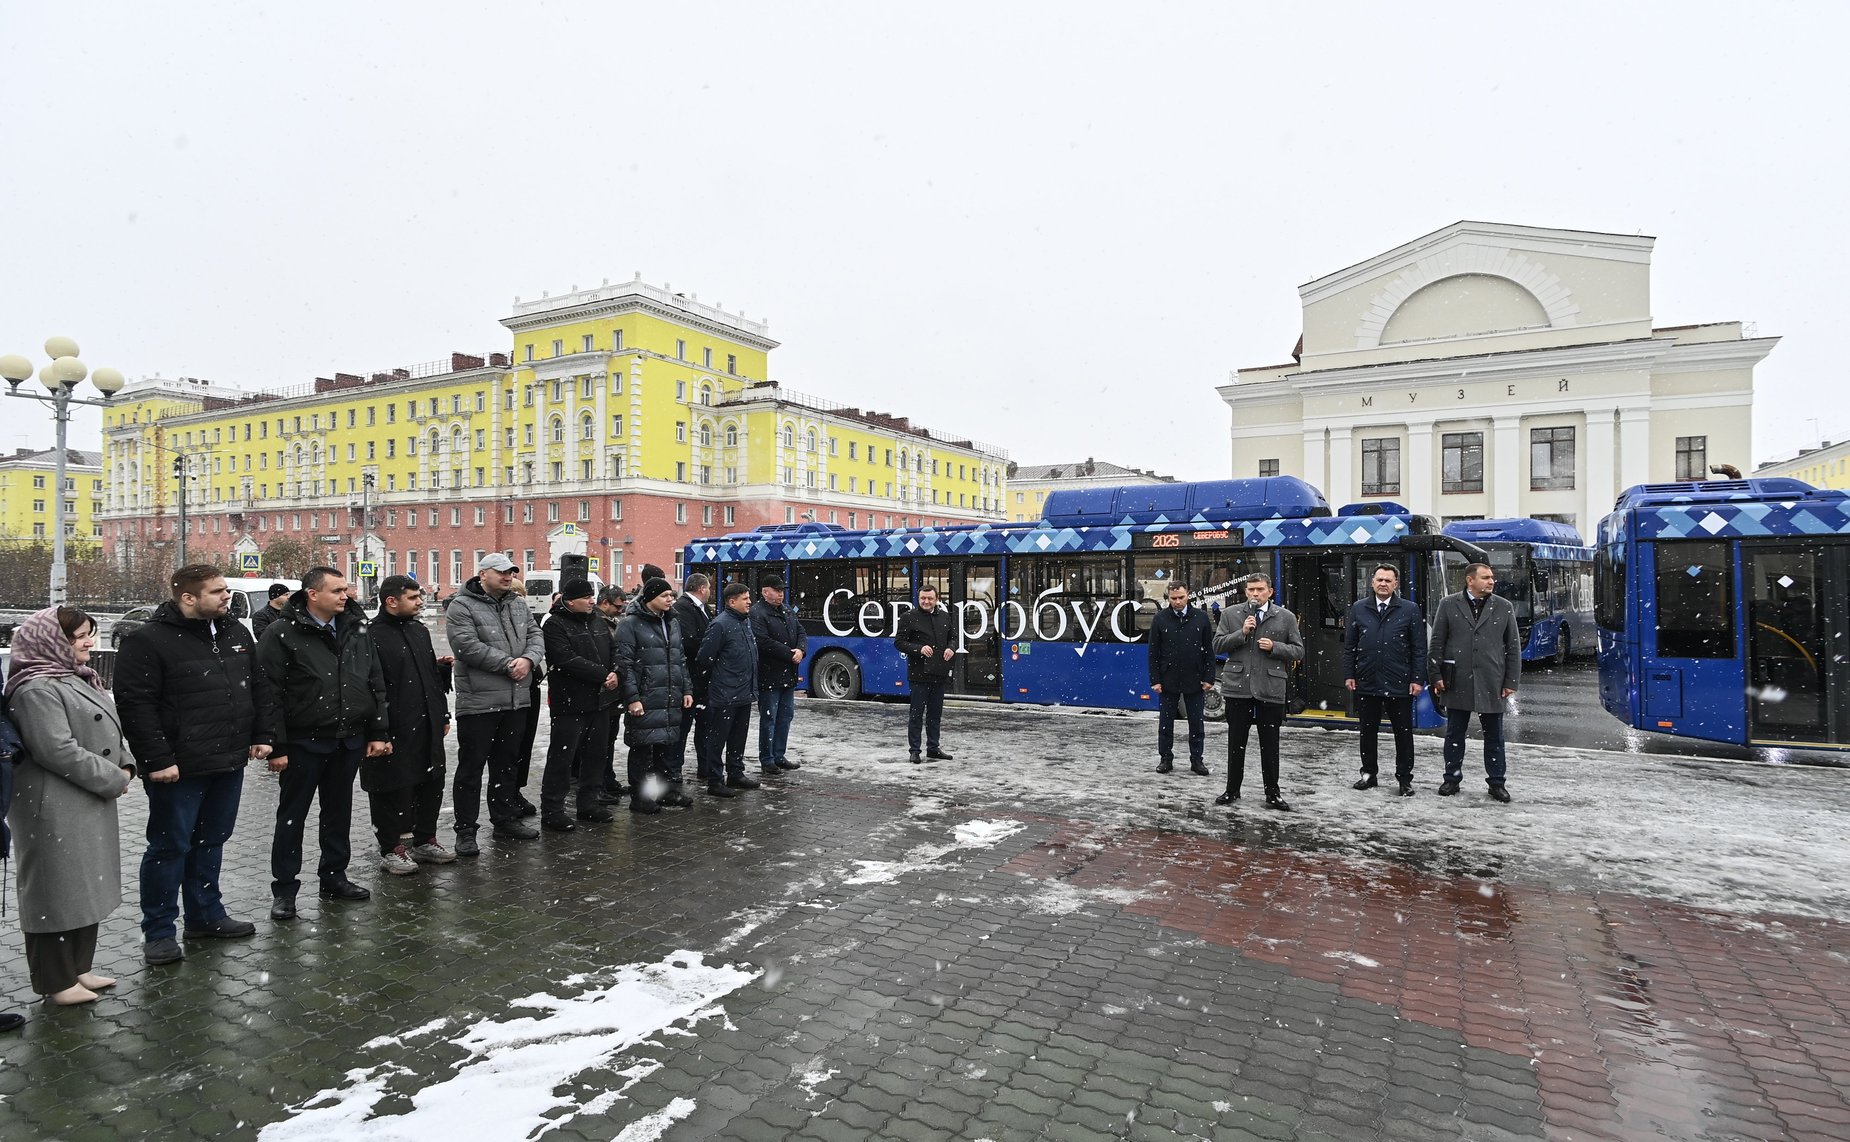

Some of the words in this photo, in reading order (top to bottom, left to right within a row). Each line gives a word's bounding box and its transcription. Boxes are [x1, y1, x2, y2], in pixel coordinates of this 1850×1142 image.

[1361, 378, 1570, 408] МУЗЕЙ
[1152, 534, 1180, 548] 2025
[822, 580, 1144, 658] Серобус
